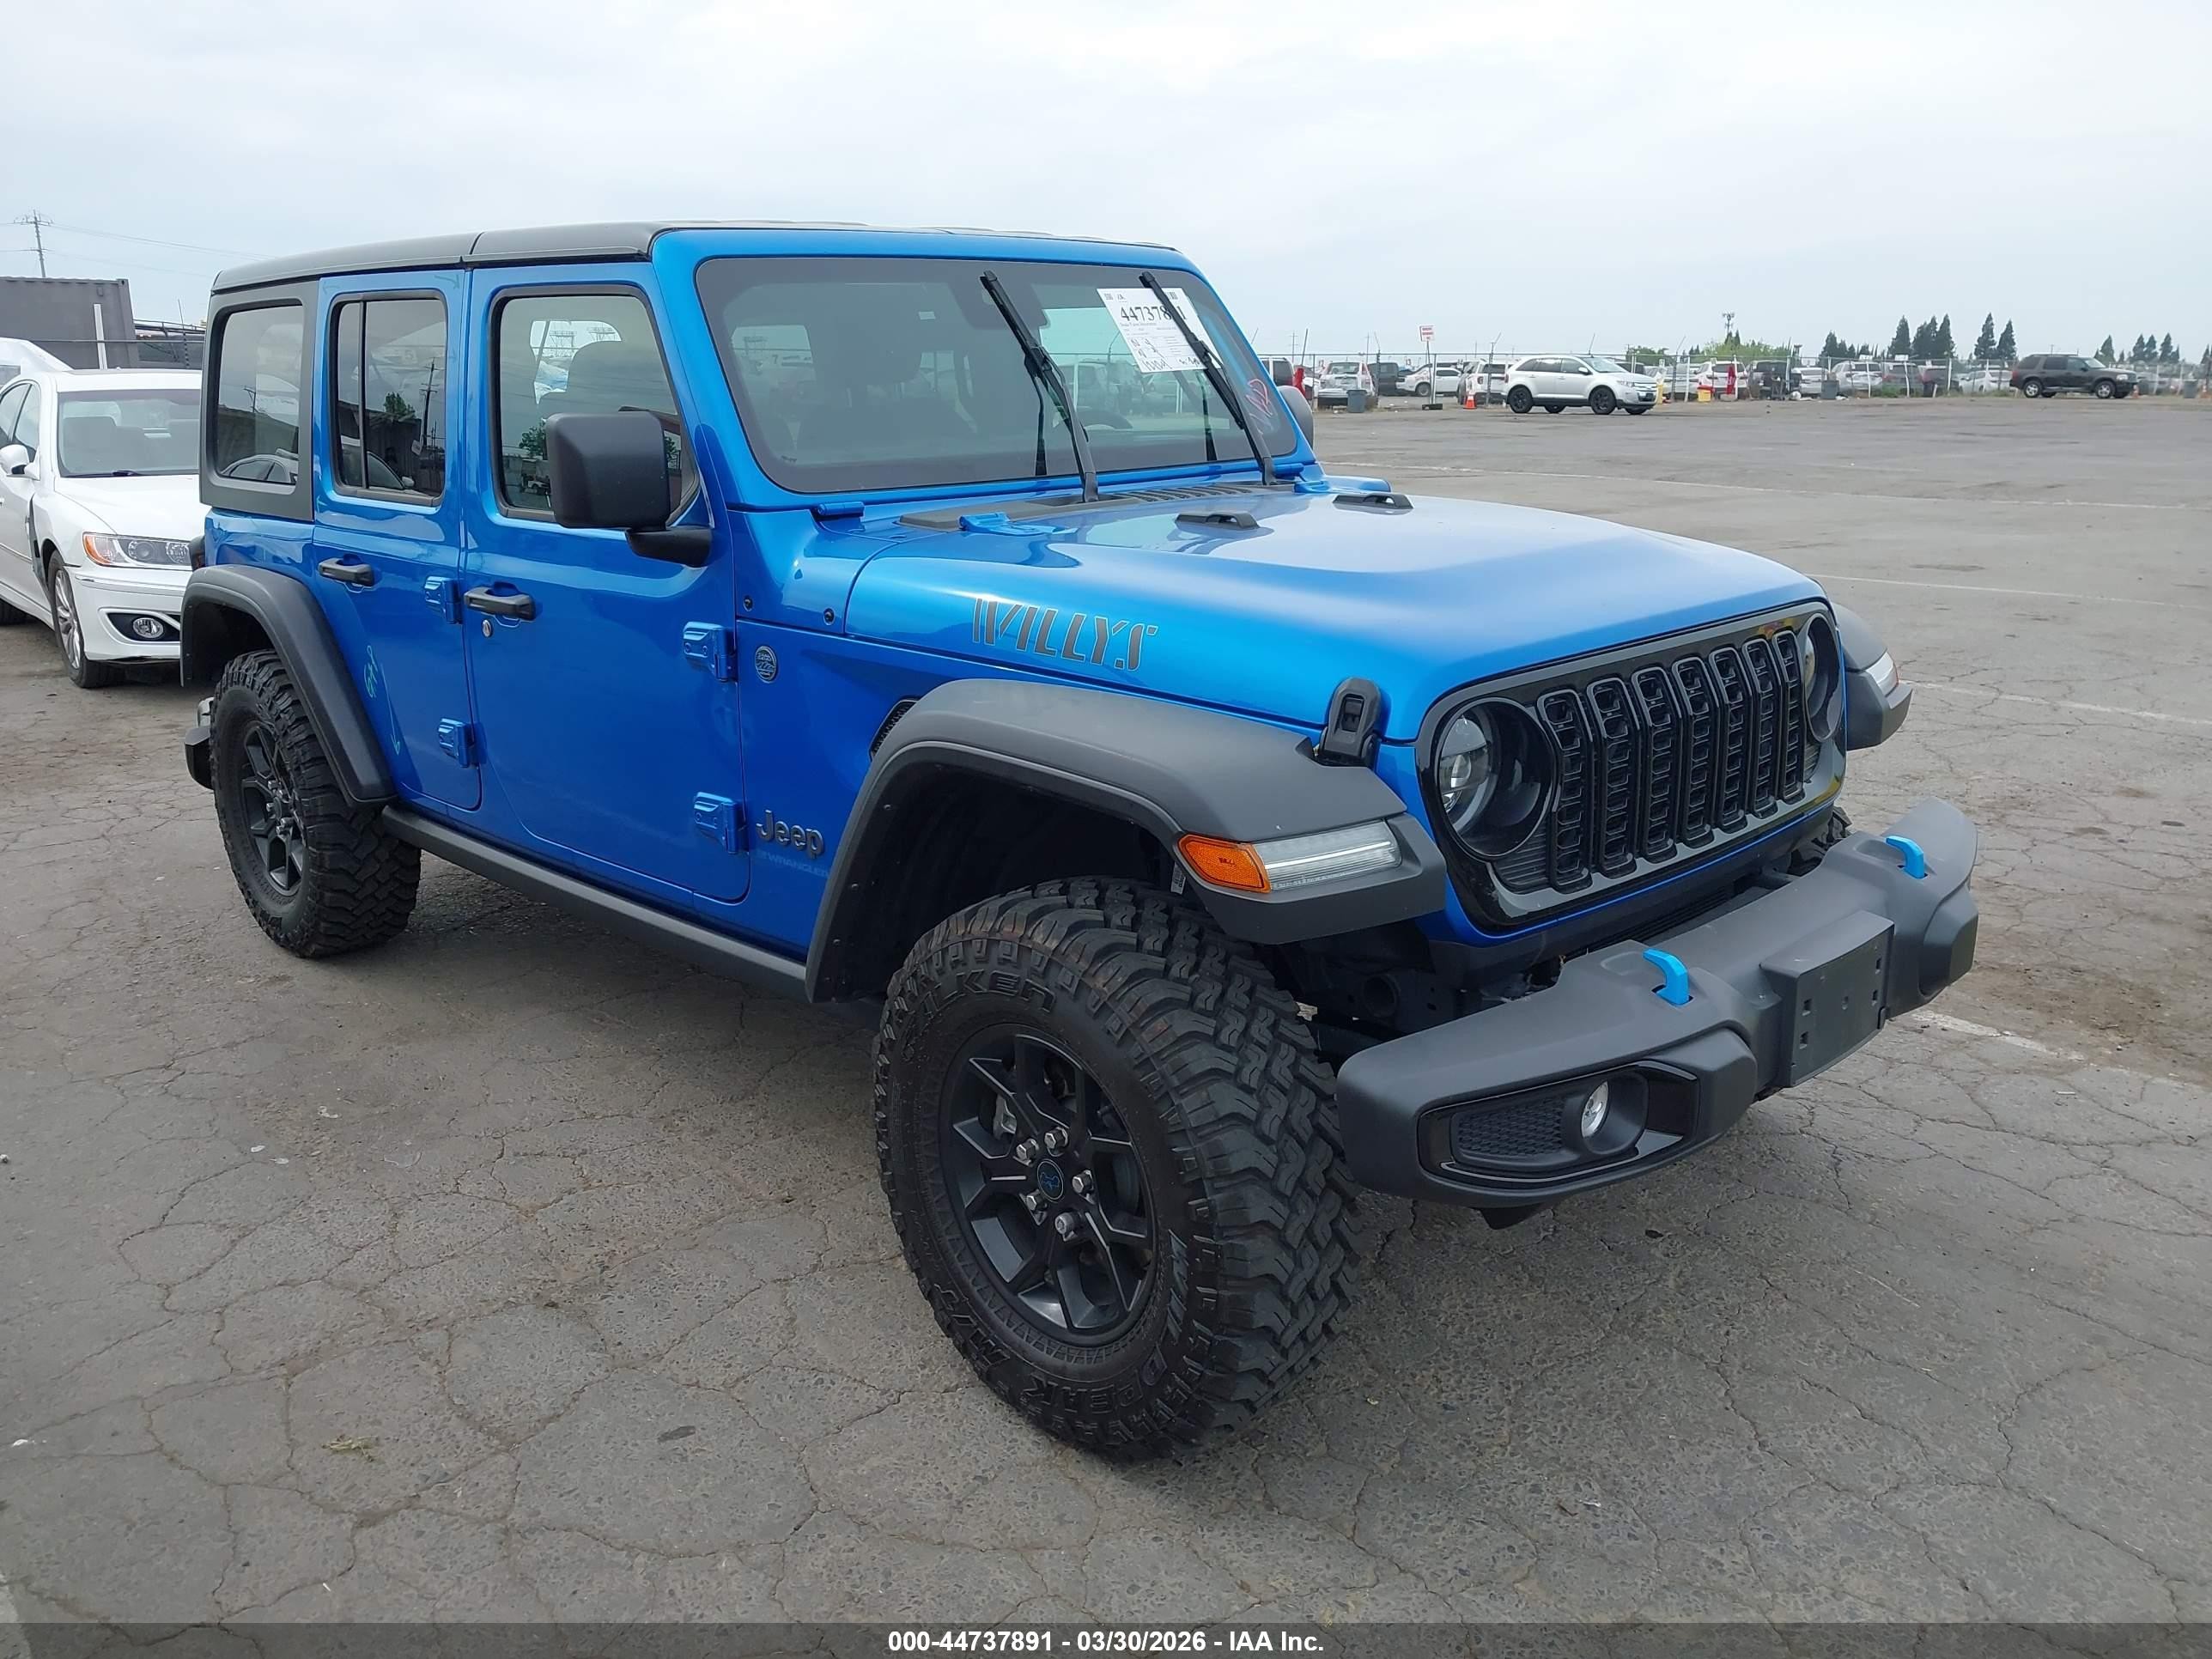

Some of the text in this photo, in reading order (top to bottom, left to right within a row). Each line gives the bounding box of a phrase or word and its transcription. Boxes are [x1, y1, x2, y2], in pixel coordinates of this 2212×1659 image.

[1120, 305, 1188, 322] 4473781
[972, 597, 1158, 672] WILLYS
[756, 809, 825, 859] Jeep
